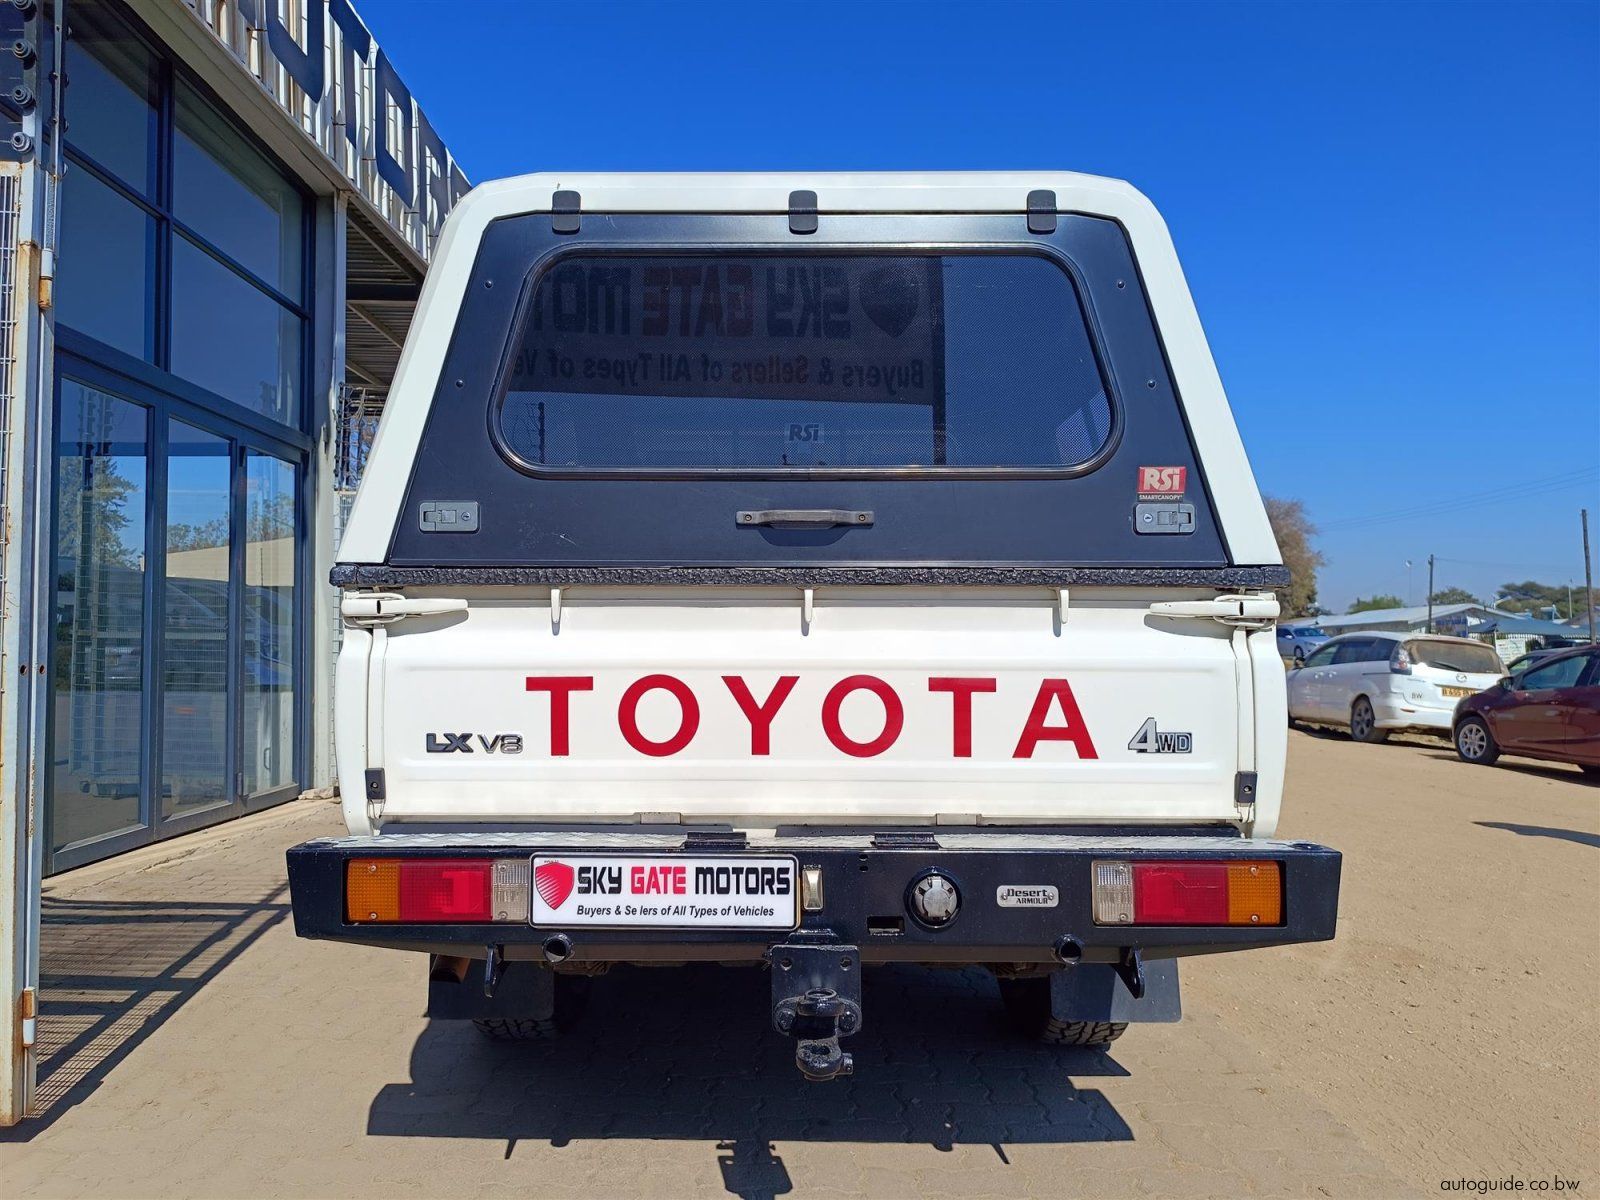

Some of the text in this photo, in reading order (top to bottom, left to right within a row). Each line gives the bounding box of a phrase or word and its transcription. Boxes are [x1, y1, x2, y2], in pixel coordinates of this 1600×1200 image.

[526, 674, 1099, 759] TOYOTA
[426, 733, 523, 754] LX V8
[1128, 717, 1192, 753] 4WD
[577, 866, 790, 895] SKY GATE MOTORS
[1007, 888, 1048, 897] Desert
[577, 905, 611, 917] Buyers
[615, 905, 621, 915] &
[661, 905, 672, 915] of
[672, 905, 686, 916] All
[689, 905, 718, 918] Types
[720, 905, 732, 916] of
[733, 905, 774, 916] Vehicles
